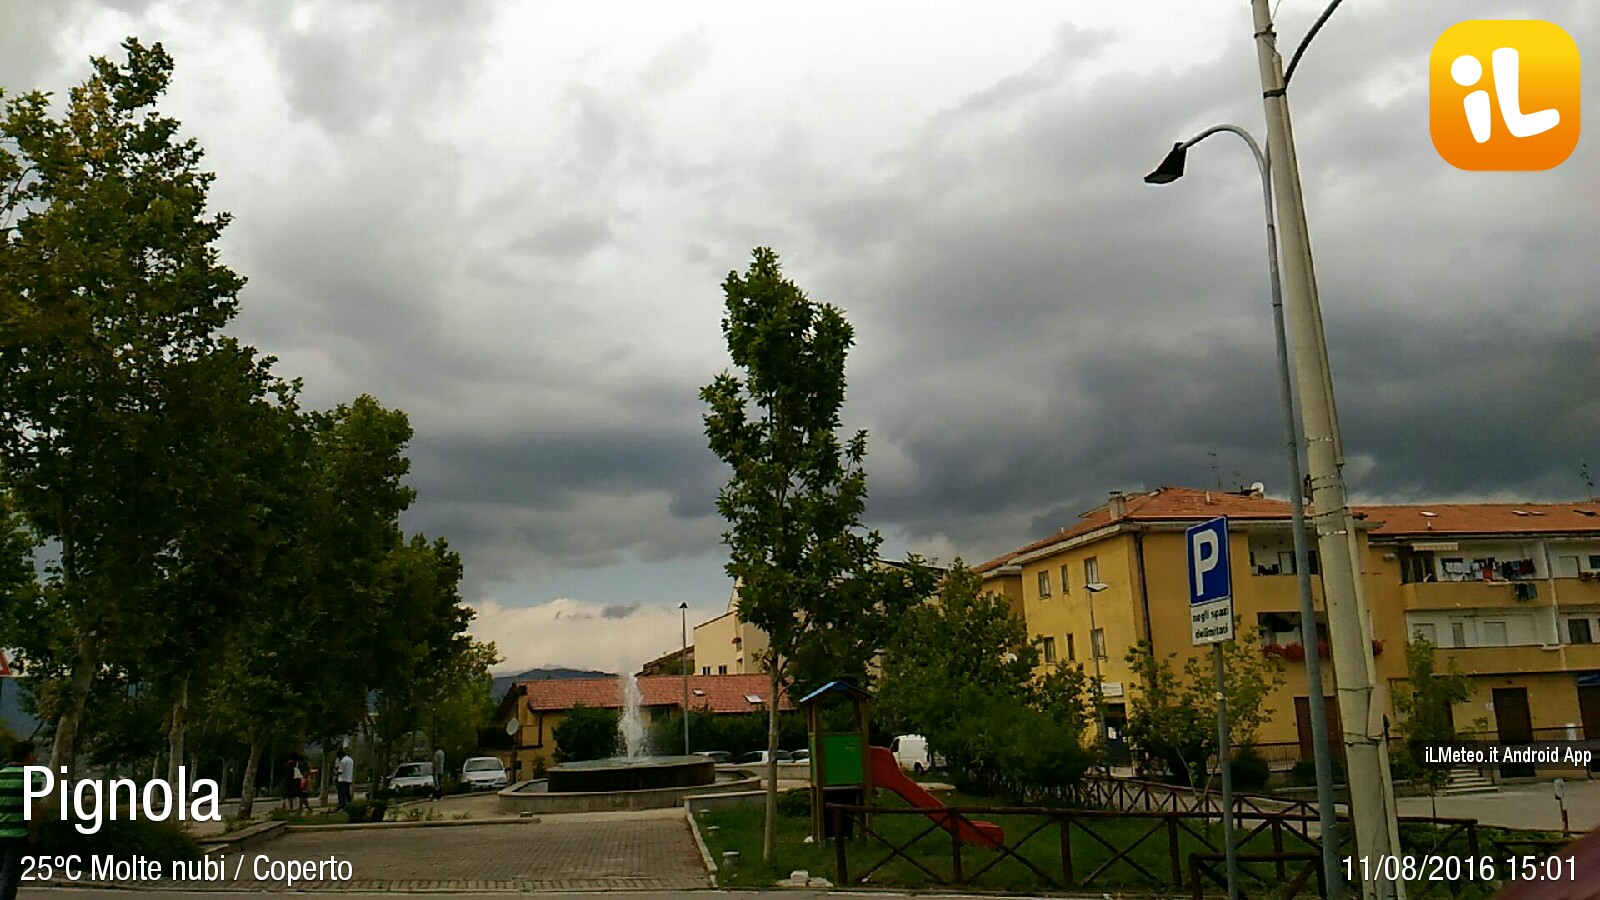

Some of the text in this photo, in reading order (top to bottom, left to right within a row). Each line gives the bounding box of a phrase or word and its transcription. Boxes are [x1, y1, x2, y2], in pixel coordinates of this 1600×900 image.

[1193, 529, 1219, 597] P
[1192, 605, 1230, 623] negli spazi
